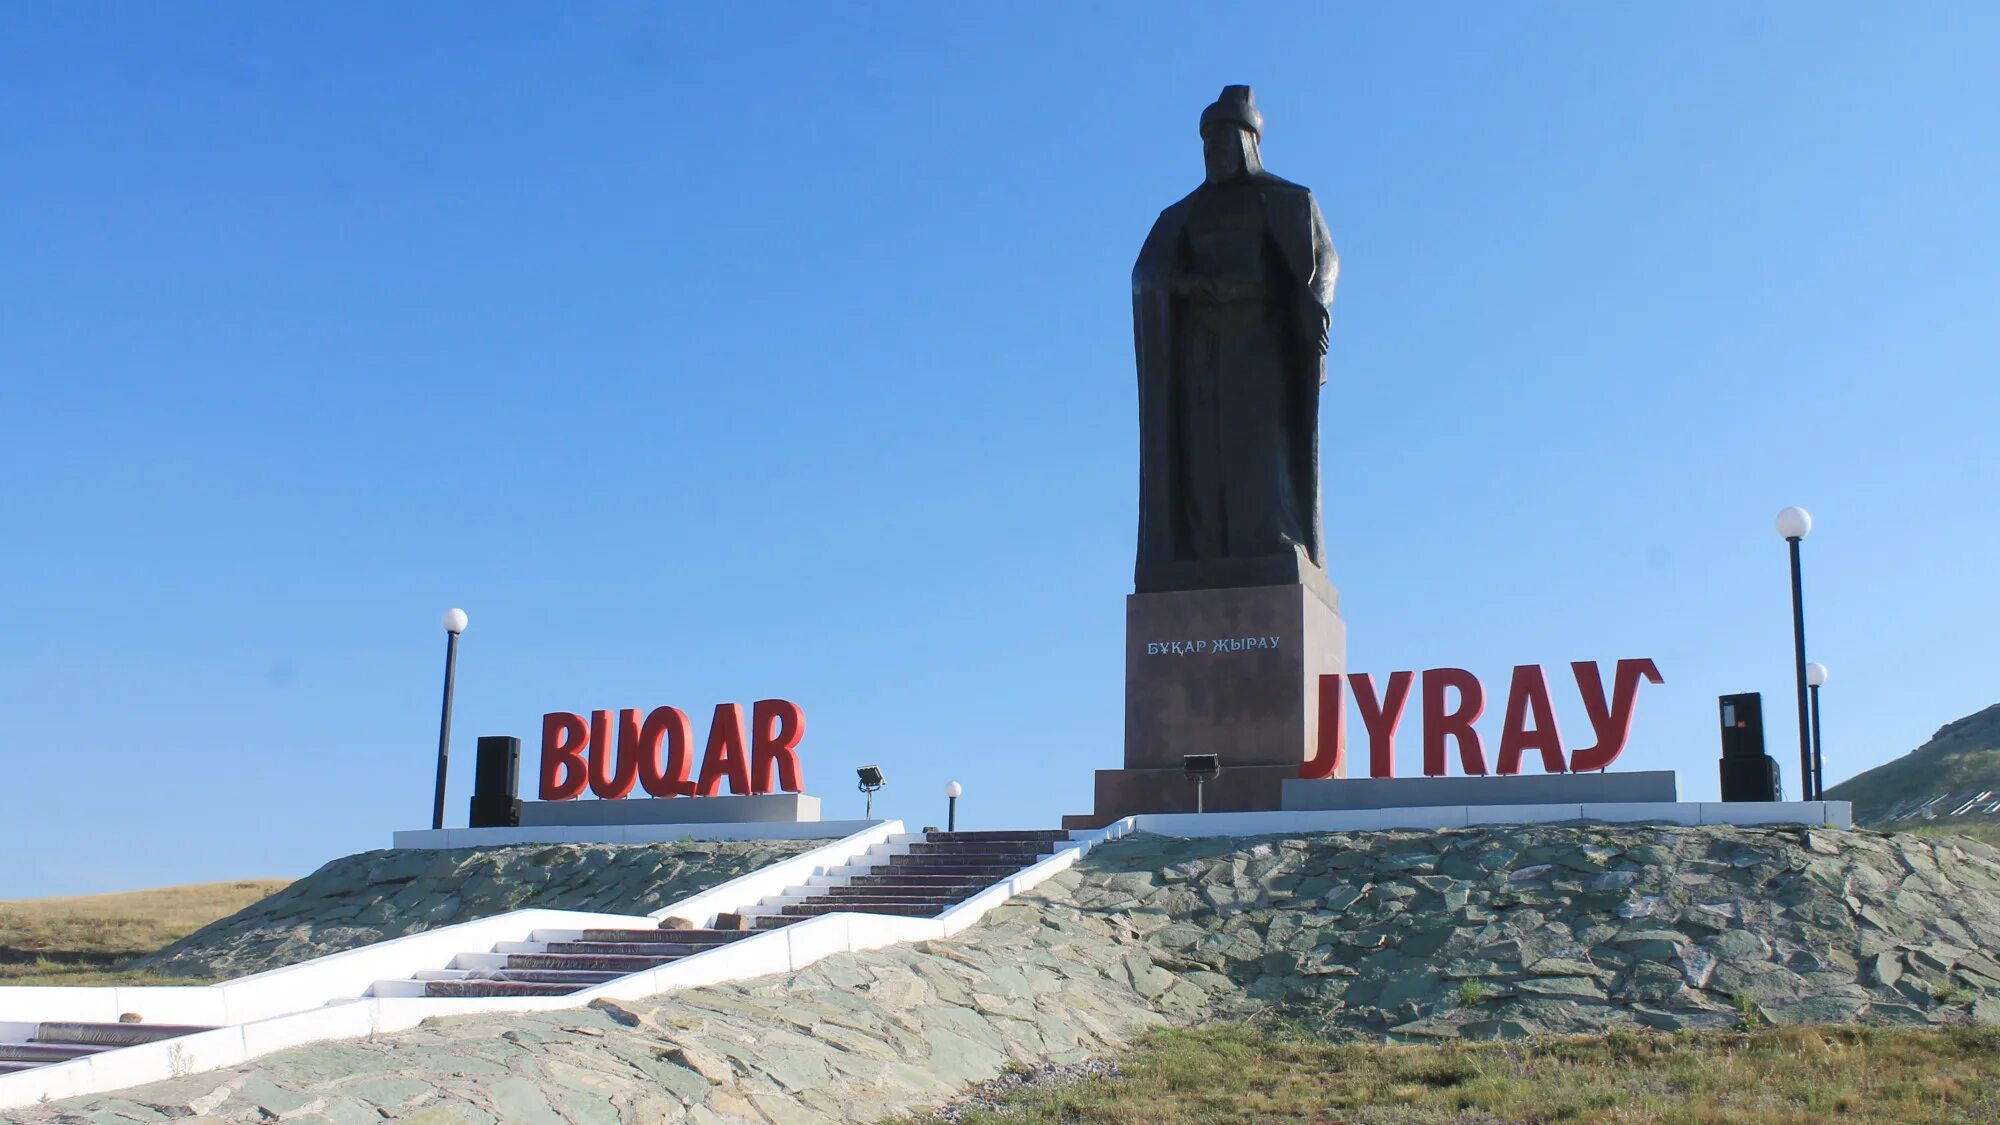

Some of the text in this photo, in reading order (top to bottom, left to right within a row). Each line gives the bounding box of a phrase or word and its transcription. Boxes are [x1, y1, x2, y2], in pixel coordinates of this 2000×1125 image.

[1147, 637, 1280, 656] БҰҚАР ЖЫРАУ
[539, 699, 805, 801] BUQAR
